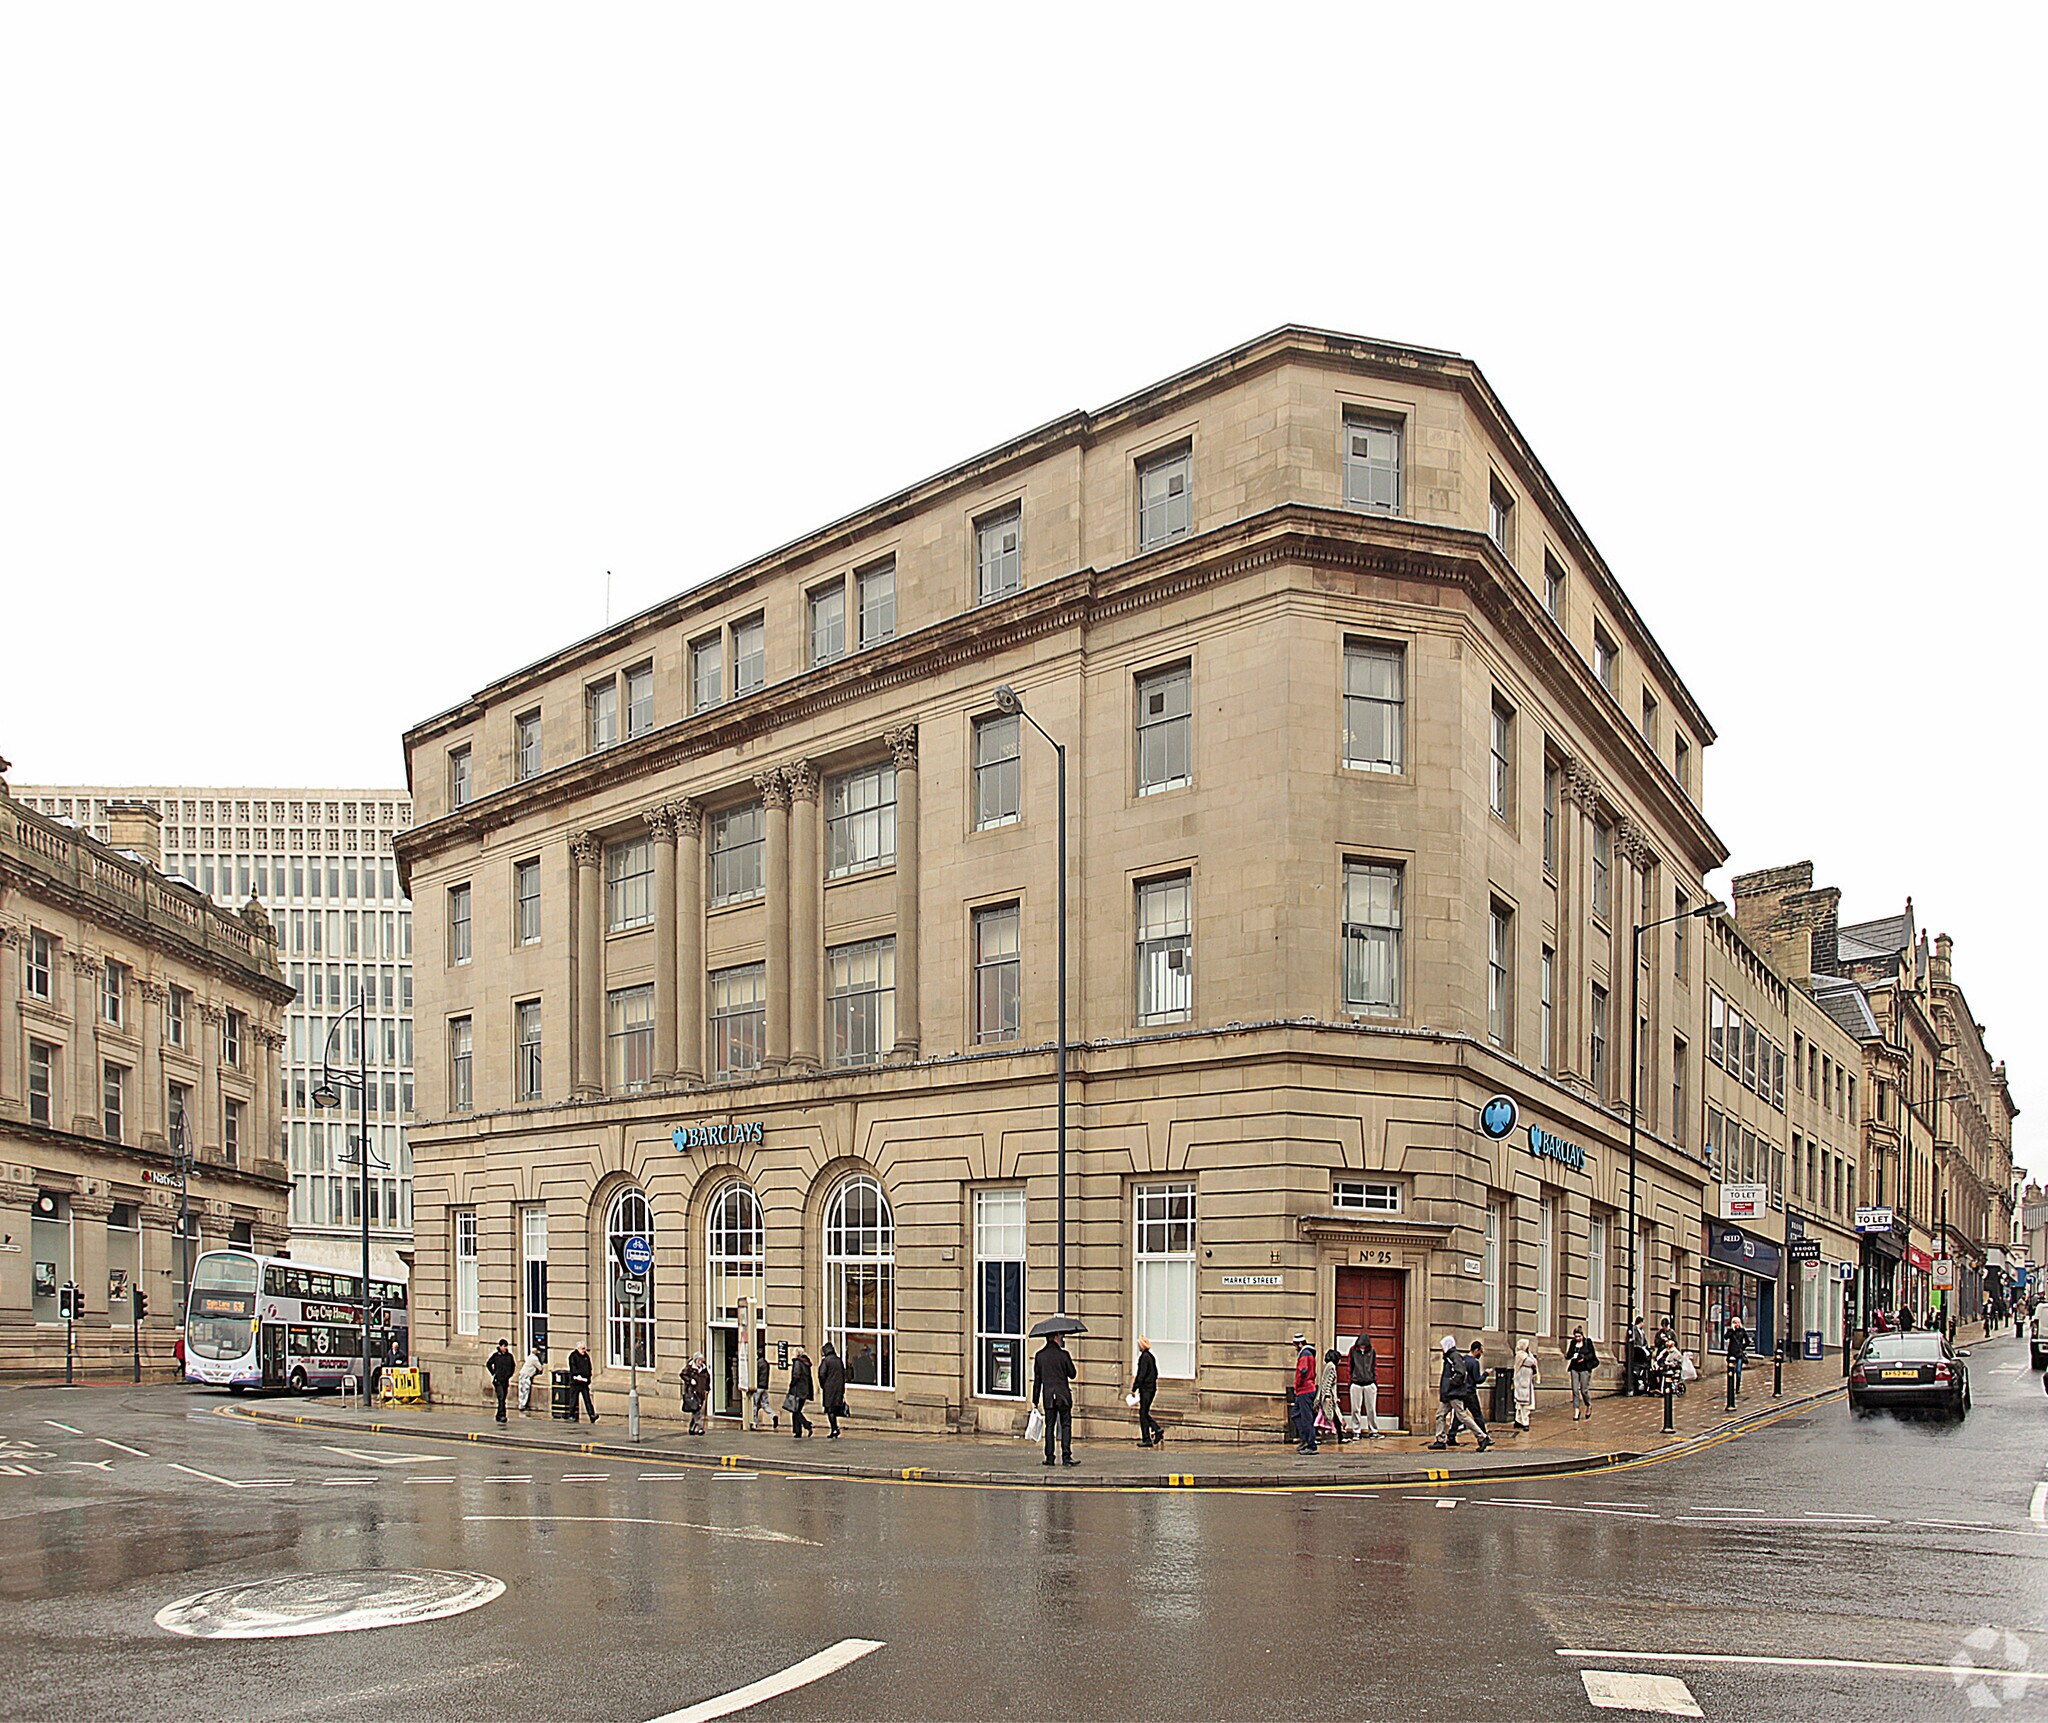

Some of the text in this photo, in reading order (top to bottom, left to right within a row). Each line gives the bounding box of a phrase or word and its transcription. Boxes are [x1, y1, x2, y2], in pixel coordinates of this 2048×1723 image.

[688, 1122, 763, 1147] BARCLAYS
[1542, 1132, 1585, 1169] BARCLAYS
[1377, 1250, 1391, 1264] 25
[627, 1283, 640, 1291] Only
